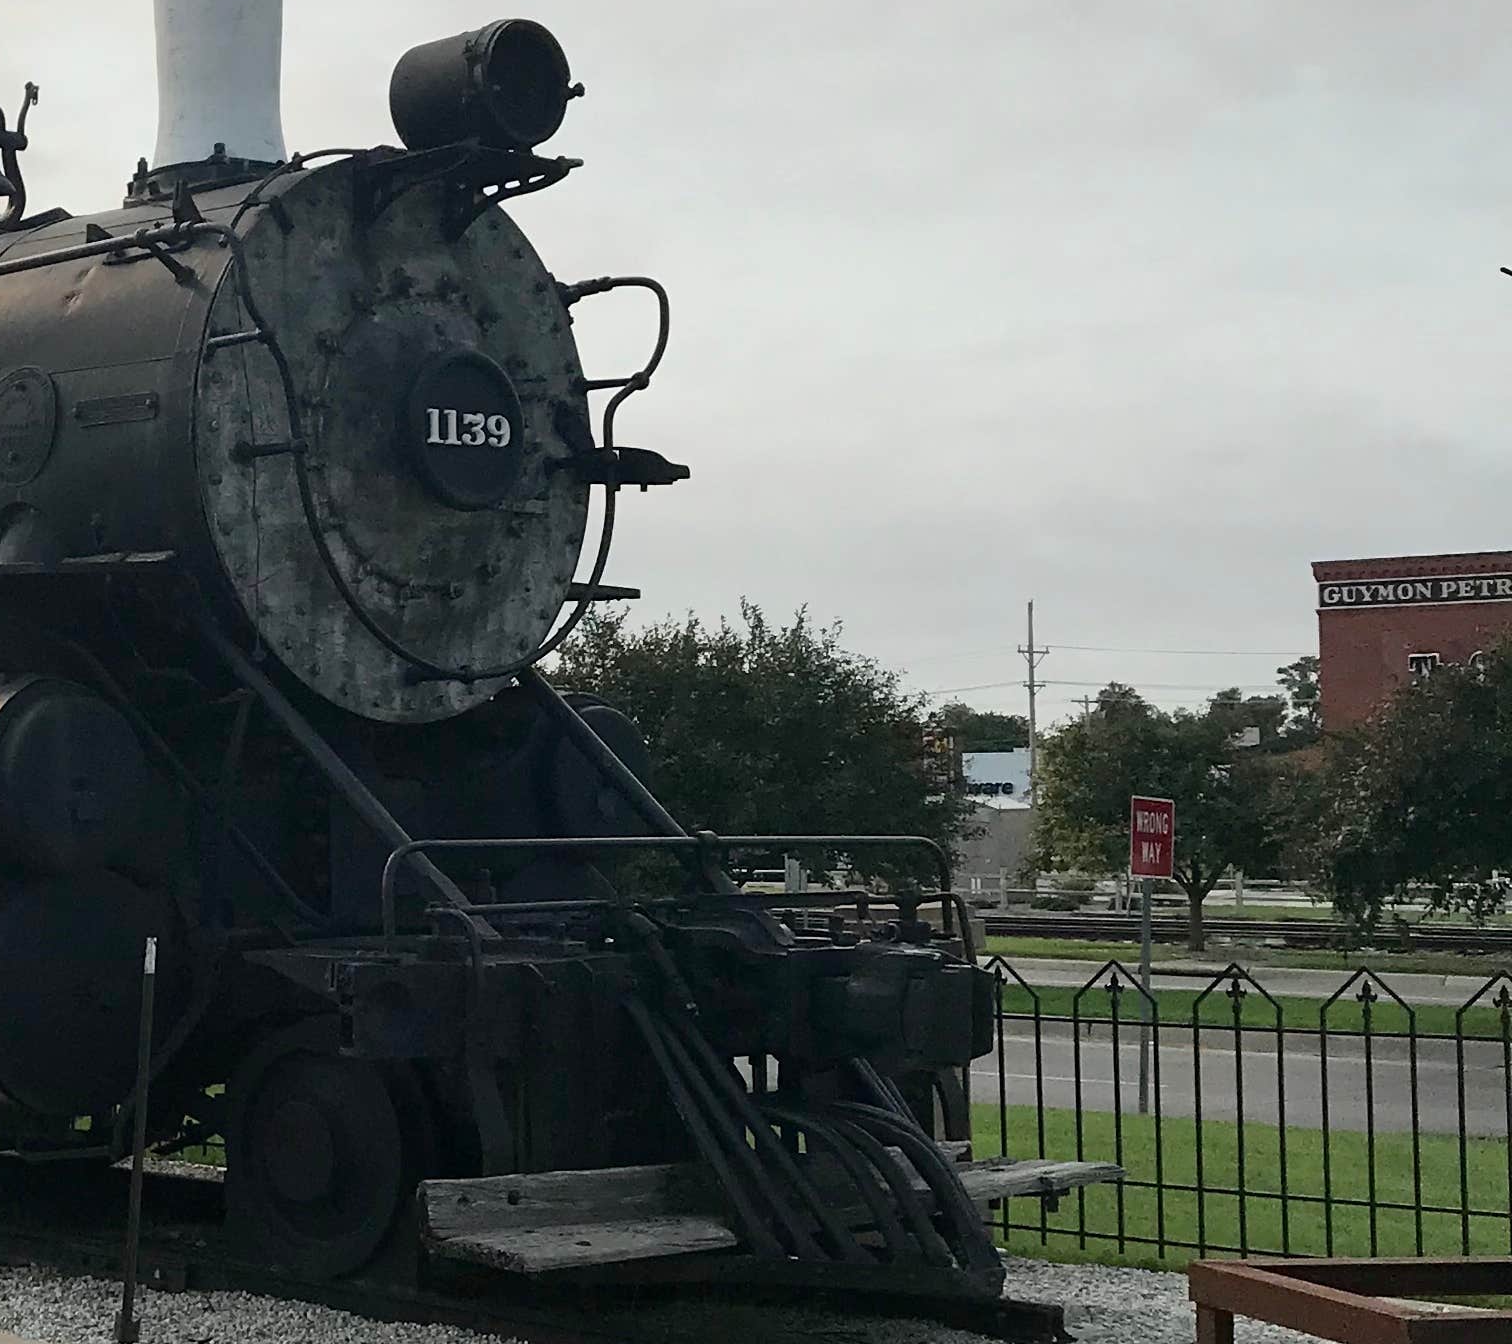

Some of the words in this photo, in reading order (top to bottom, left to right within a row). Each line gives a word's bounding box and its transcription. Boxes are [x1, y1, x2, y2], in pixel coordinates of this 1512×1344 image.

[426, 408, 511, 447] 1139
[1323, 582, 1433, 603] GUYMON
[1136, 811, 1169, 834] WRONG
[1141, 841, 1162, 864] WAY
